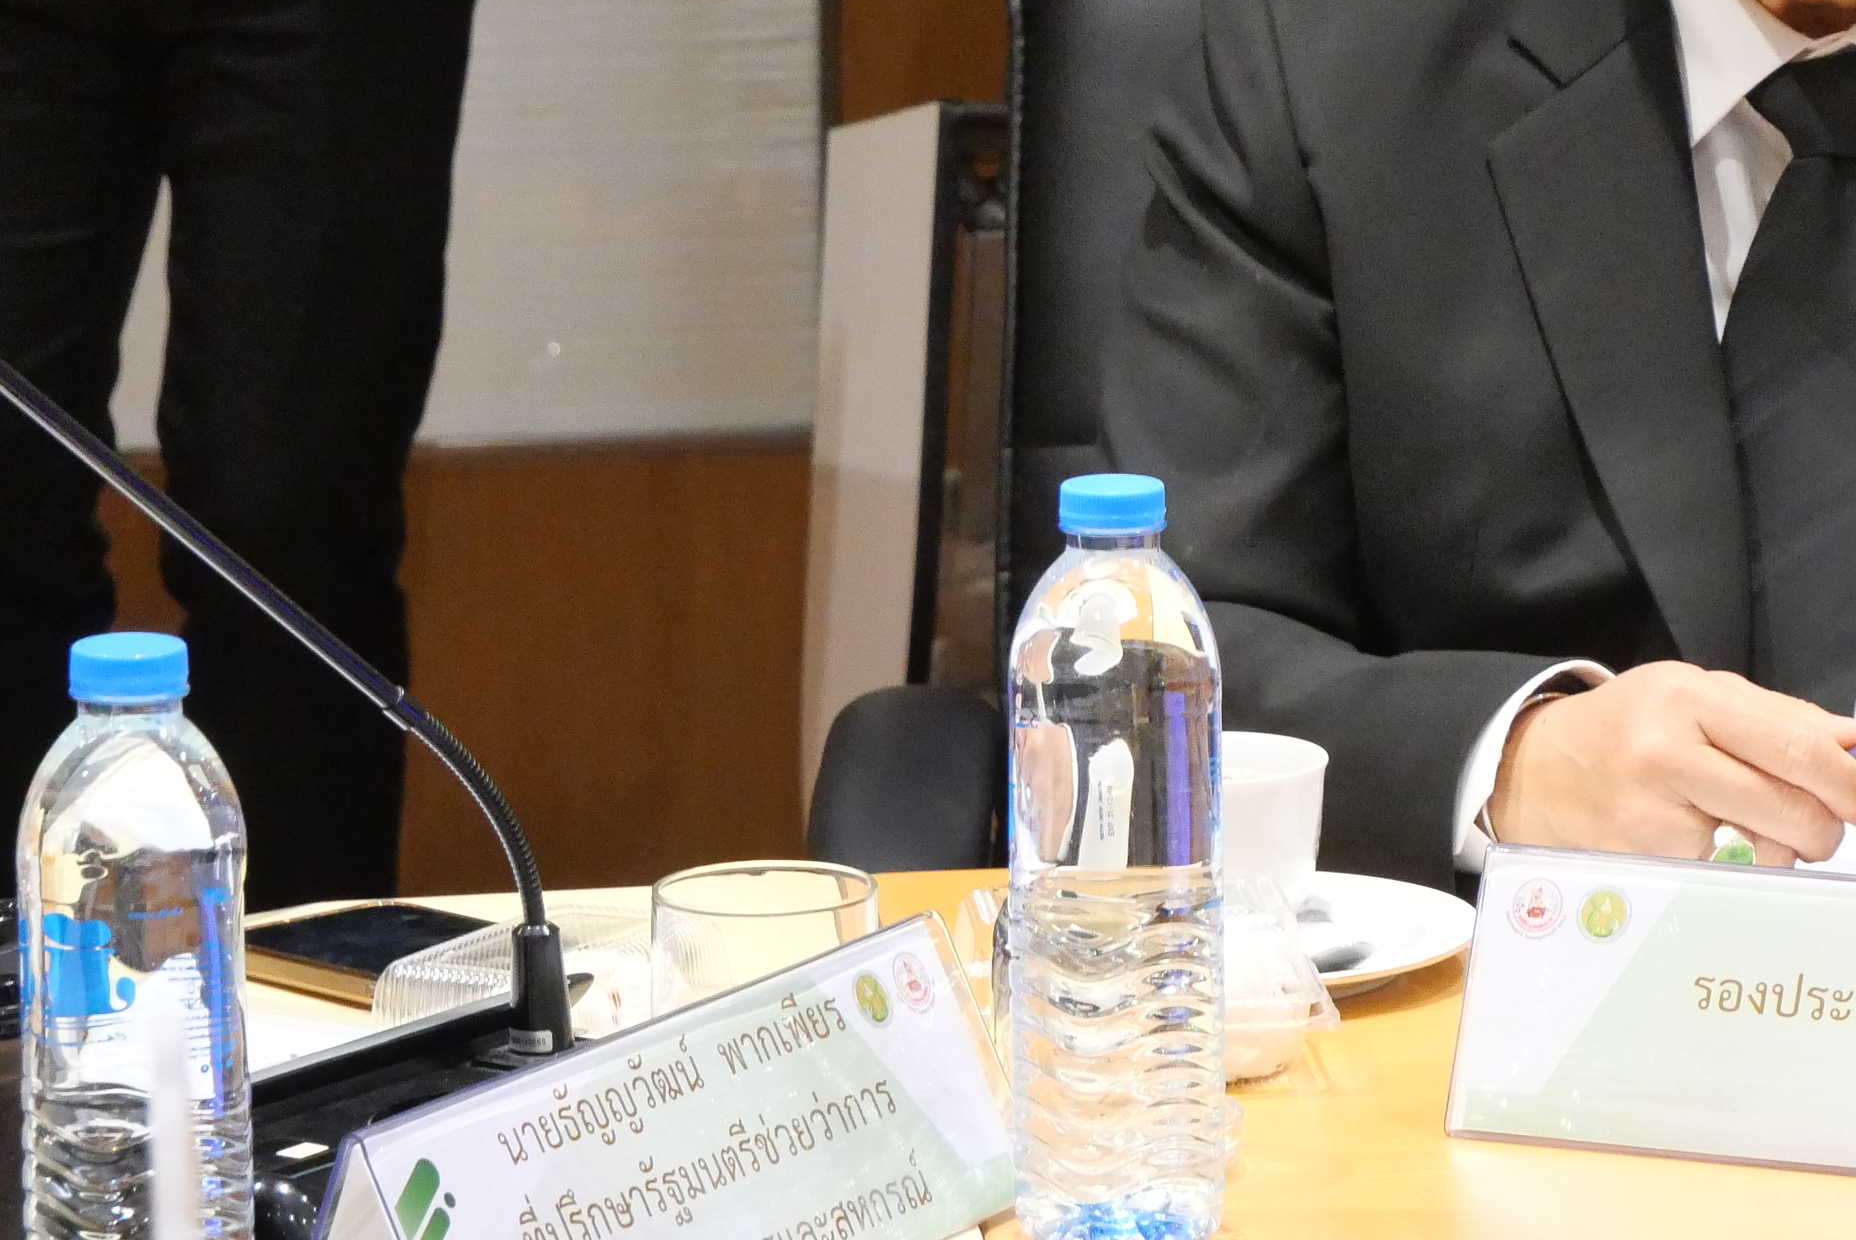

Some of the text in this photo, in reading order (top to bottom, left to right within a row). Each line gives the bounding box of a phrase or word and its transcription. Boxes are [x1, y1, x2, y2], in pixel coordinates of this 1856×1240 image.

[497, 992, 848, 1166] นายธัญญวัฒน์ พากเพียร
[761, 1147, 933, 1240] ละสหกรณ์
